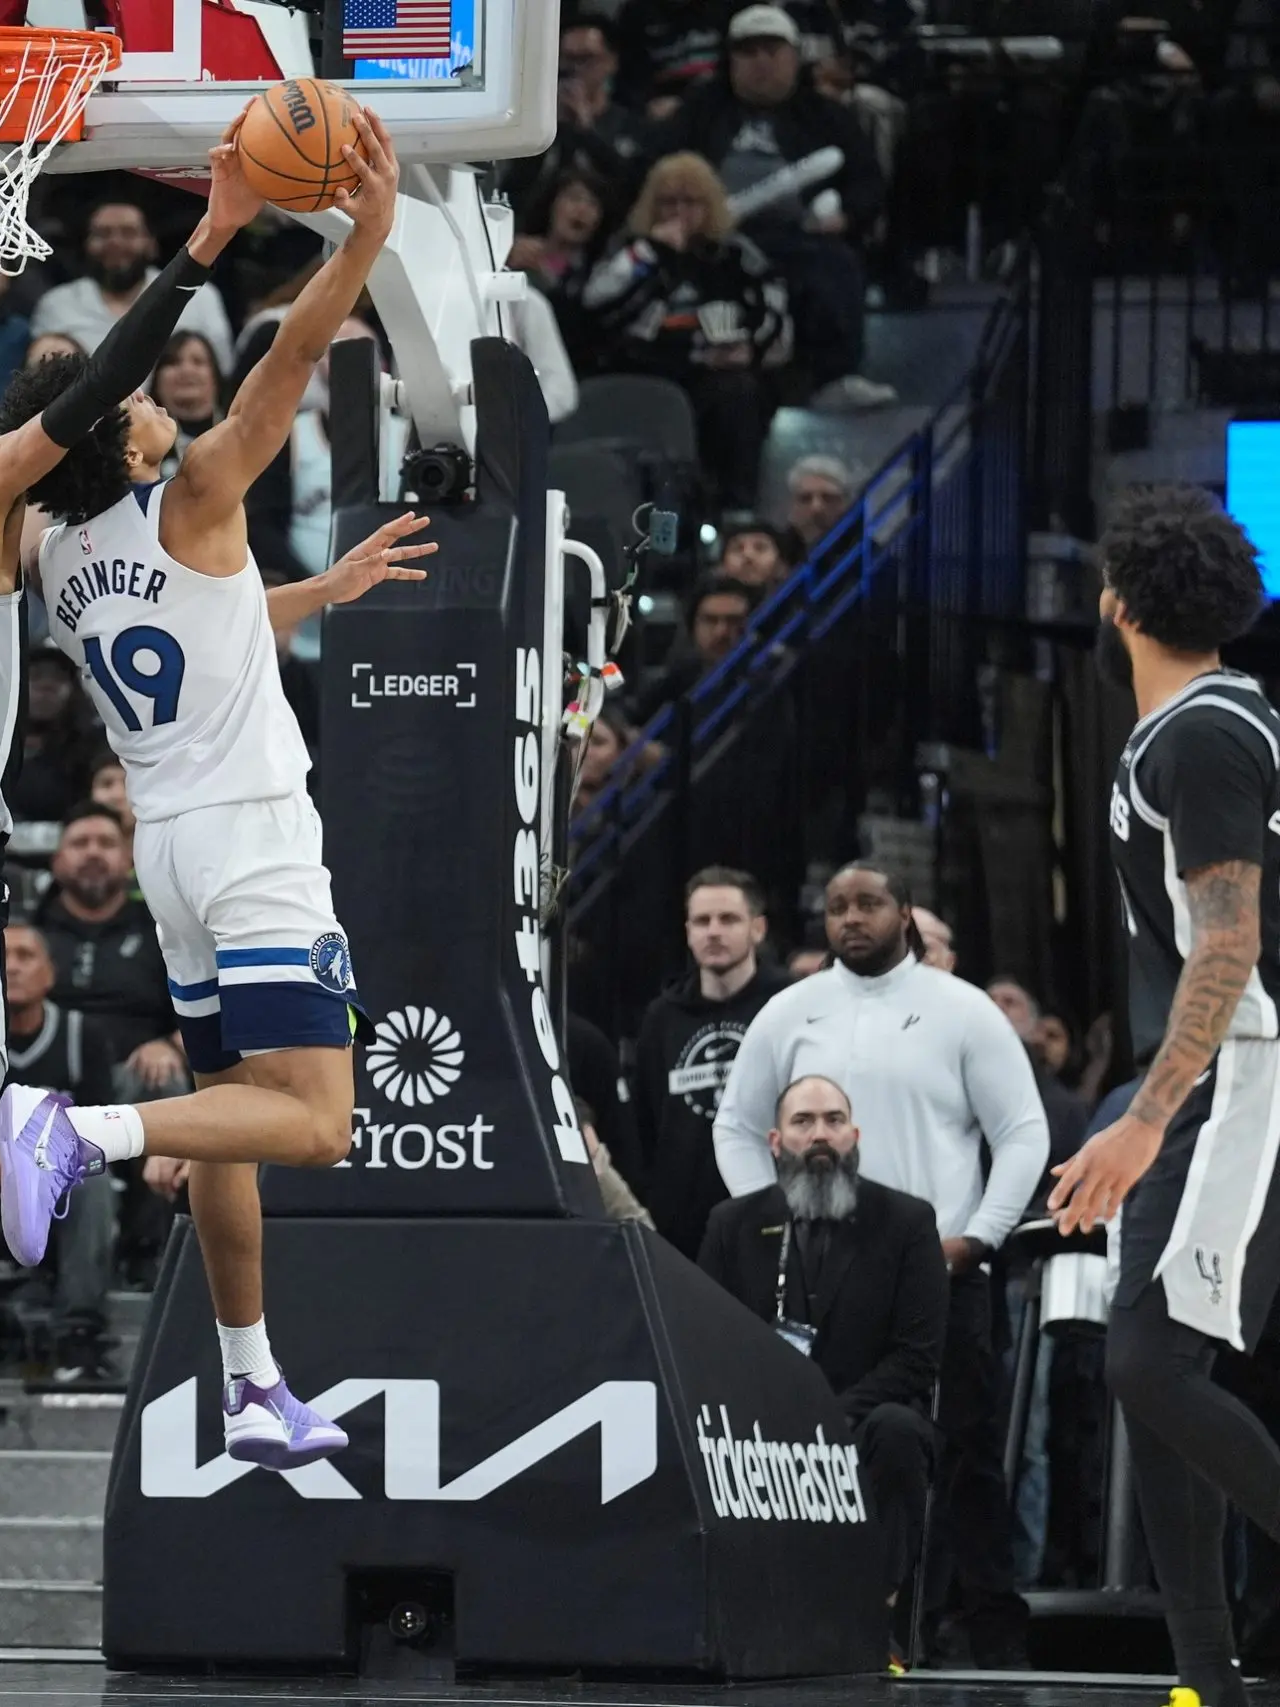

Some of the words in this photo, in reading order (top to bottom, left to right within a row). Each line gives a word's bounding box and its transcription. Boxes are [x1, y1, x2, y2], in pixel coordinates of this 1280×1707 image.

[56, 559, 167, 633] BERINGER
[82, 625, 186, 732] 19
[369, 675, 460, 696] LEDGER
[513, 646, 589, 1164] bet365
[311, 934, 333, 970] MINNESOTA
[331, 1107, 495, 1170] Frost
[696, 1404, 867, 1524] ticketmaster
